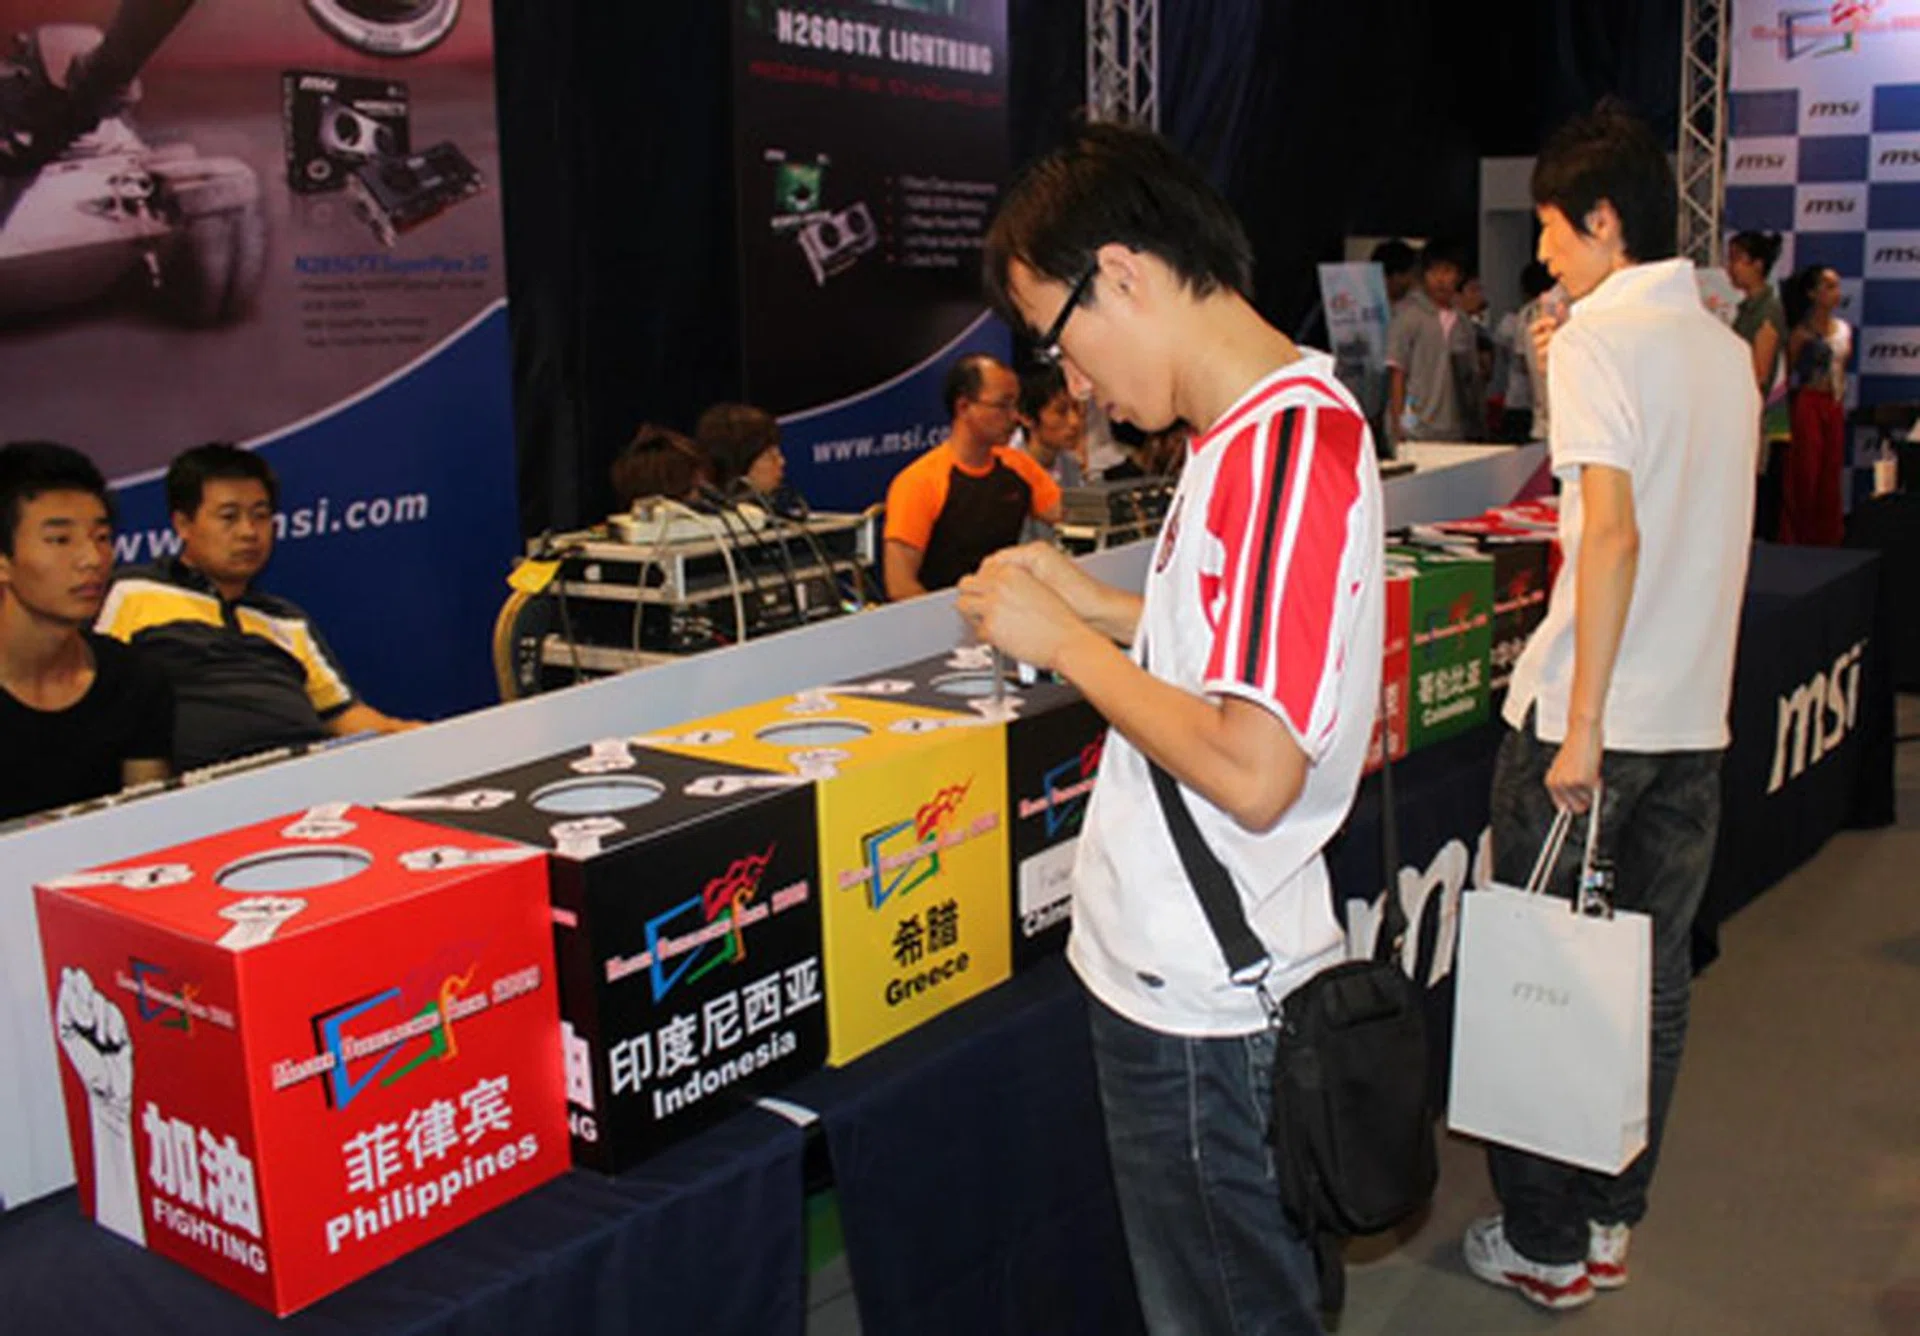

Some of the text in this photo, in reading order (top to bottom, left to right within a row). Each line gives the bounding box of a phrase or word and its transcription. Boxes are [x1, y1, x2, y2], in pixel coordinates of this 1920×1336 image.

[777, 9, 994, 76] N260GTX LIGHTNING
[1808, 101, 1861, 117] msi
[1735, 154, 1785, 170] msi
[1804, 197, 1856, 214] msi
[1766, 638, 1867, 796] msi
[885, 951, 969, 1007] Greece
[608, 956, 822, 1096] 印度尼西亚
[652, 1030, 798, 1120] Indonesia
[141, 1100, 264, 1240] 加油
[342, 1074, 513, 1193] 菲律宾
[152, 1196, 268, 1275] FIGHTING
[326, 1133, 539, 1255] Philippines
